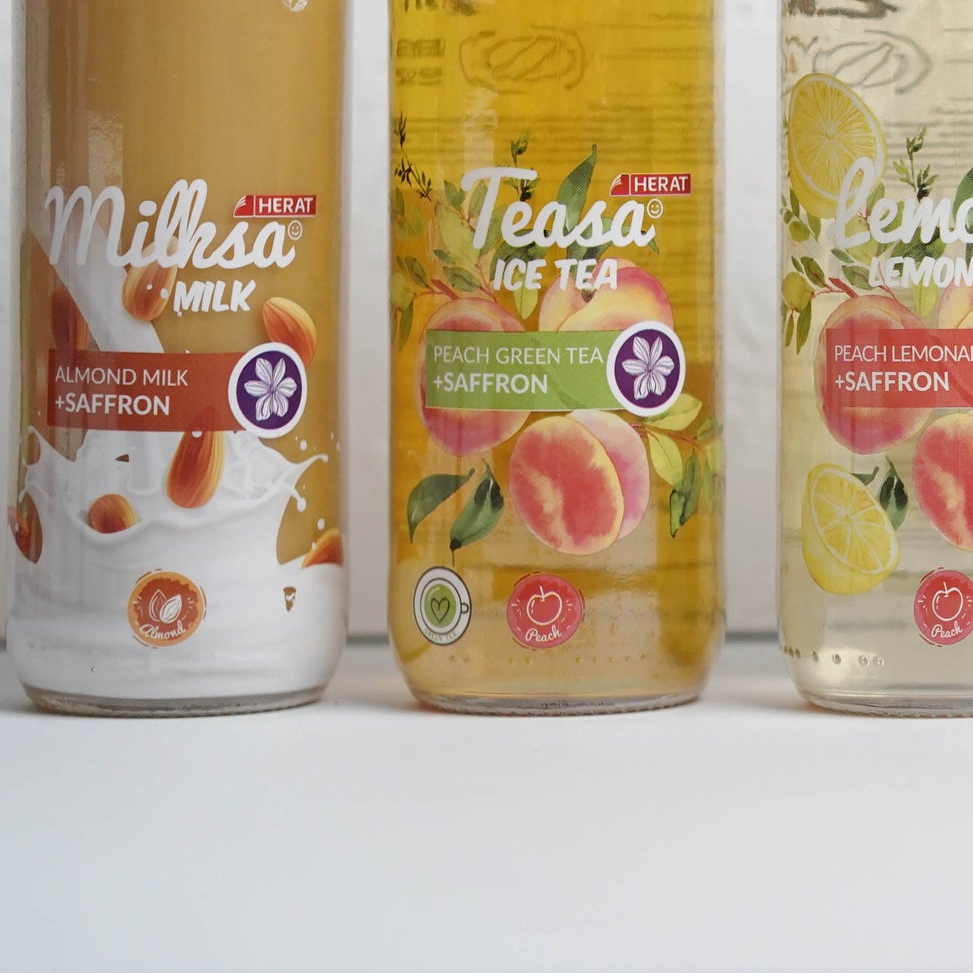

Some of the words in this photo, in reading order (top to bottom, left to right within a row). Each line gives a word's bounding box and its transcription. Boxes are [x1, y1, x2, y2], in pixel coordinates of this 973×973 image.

[634, 176, 689, 192] HERAT
[258, 196, 314, 214] HERAT
[461, 166, 656, 250] Teasa
[45, 178, 296, 269] Milksa
[493, 258, 547, 291] ICE
[554, 258, 619, 291] TEA
[173, 280, 256, 313] MILK
[433, 346, 489, 364] PEACH
[495, 347, 561, 365] GREEN
[566, 347, 604, 364] TEA
[834, 345, 887, 362] PEACH
[55, 366, 137, 386] ALMOND
[143, 369, 189, 387] MILK
[433, 372, 548, 395] +SAFFRON
[834, 371, 950, 392] +SAFFRON
[55, 392, 170, 416] +SAFFRON
[139, 621, 186, 641] Almond
[525, 625, 562, 643] Peach
[930, 622, 963, 640] Peach
